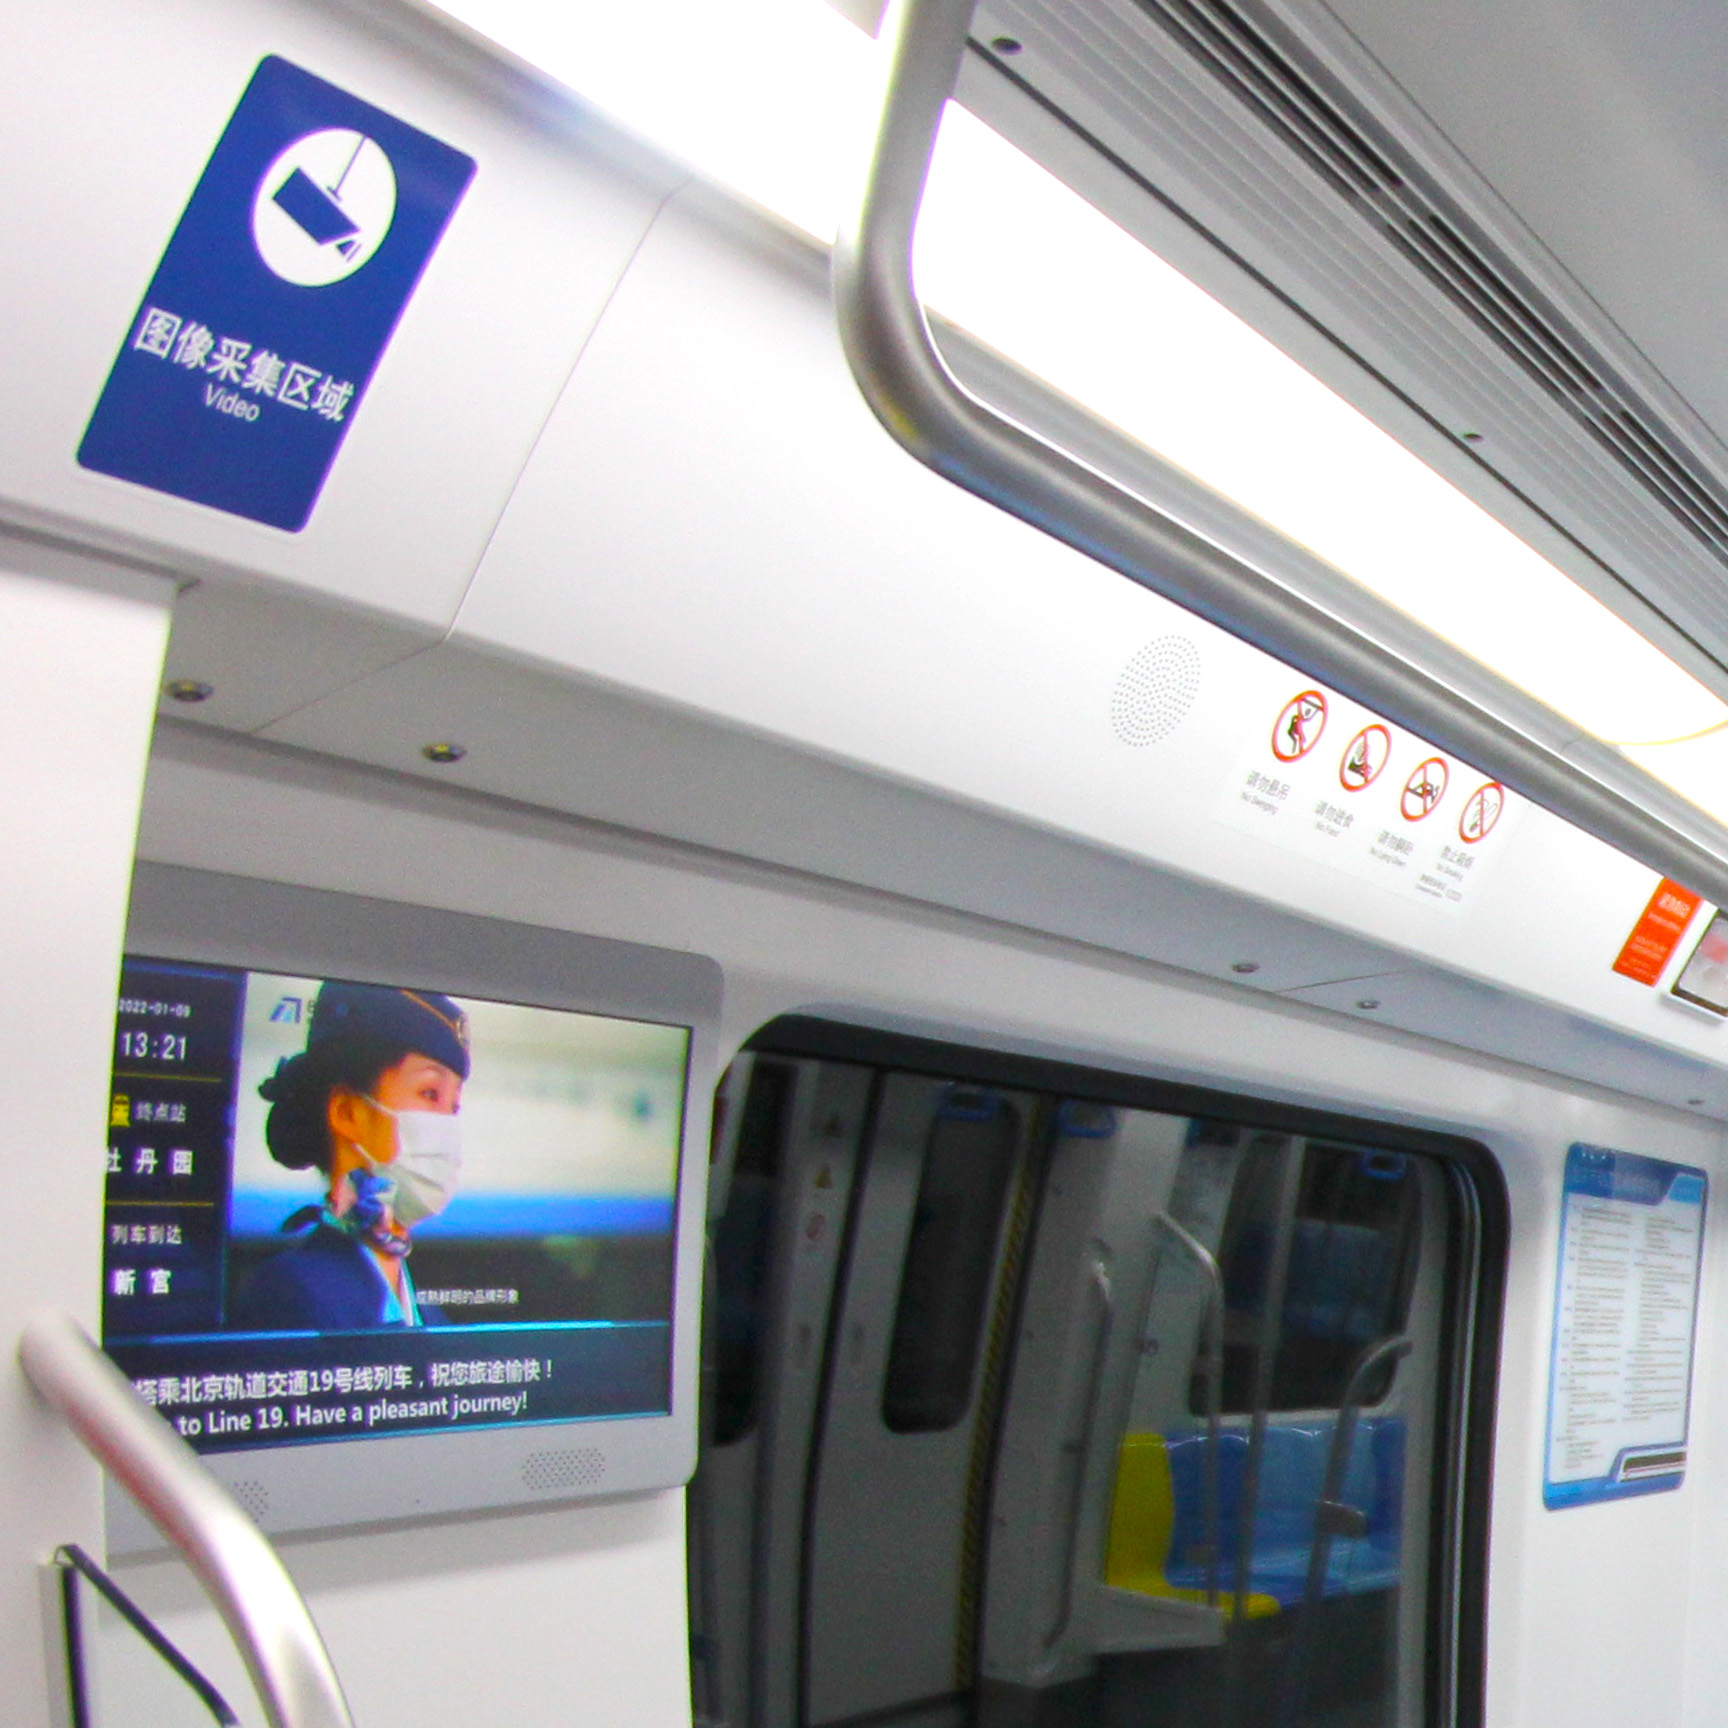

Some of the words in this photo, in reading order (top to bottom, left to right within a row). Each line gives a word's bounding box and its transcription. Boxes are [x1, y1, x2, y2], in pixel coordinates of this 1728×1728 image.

[134, 306, 355, 422] 图像采集区域
[205, 383, 260, 422] Video
[123, 1033, 187, 1060] 13:21
[135, 1102, 186, 1123] 终点站
[111, 1224, 182, 1245] 列车到达
[113, 1268, 171, 1295] 新宫
[178, 1416, 202, 1436] to
[208, 1411, 252, 1434] Line
[257, 1408, 289, 1429] 19.
[295, 1404, 347, 1427] Have
[351, 1407, 363, 1422] a
[368, 1397, 449, 1426] pleasant
[450, 1390, 528, 1420] journey!
